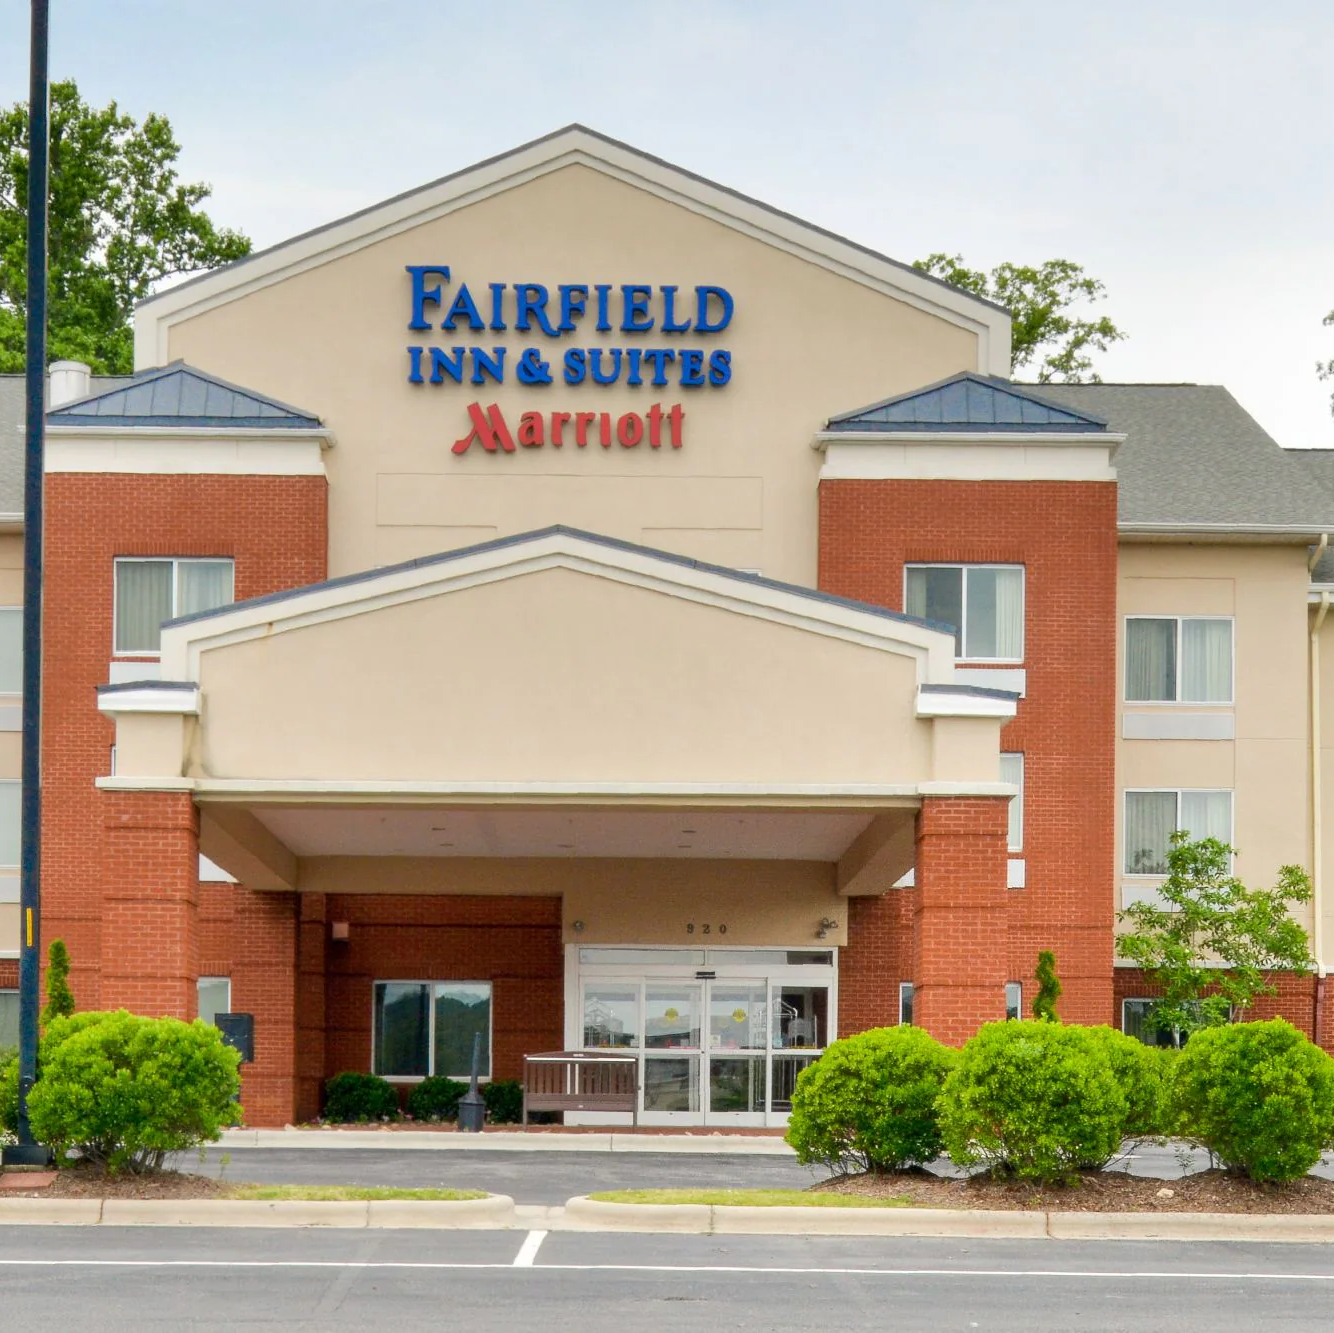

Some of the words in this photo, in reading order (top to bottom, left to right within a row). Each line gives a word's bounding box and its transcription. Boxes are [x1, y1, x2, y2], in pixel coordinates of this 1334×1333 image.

[405, 265, 735, 338] FAIRFIELD
[407, 346, 507, 385] INN
[515, 347, 555, 385] &
[563, 347, 733, 386] SUITES
[450, 402, 686, 455] Marriott
